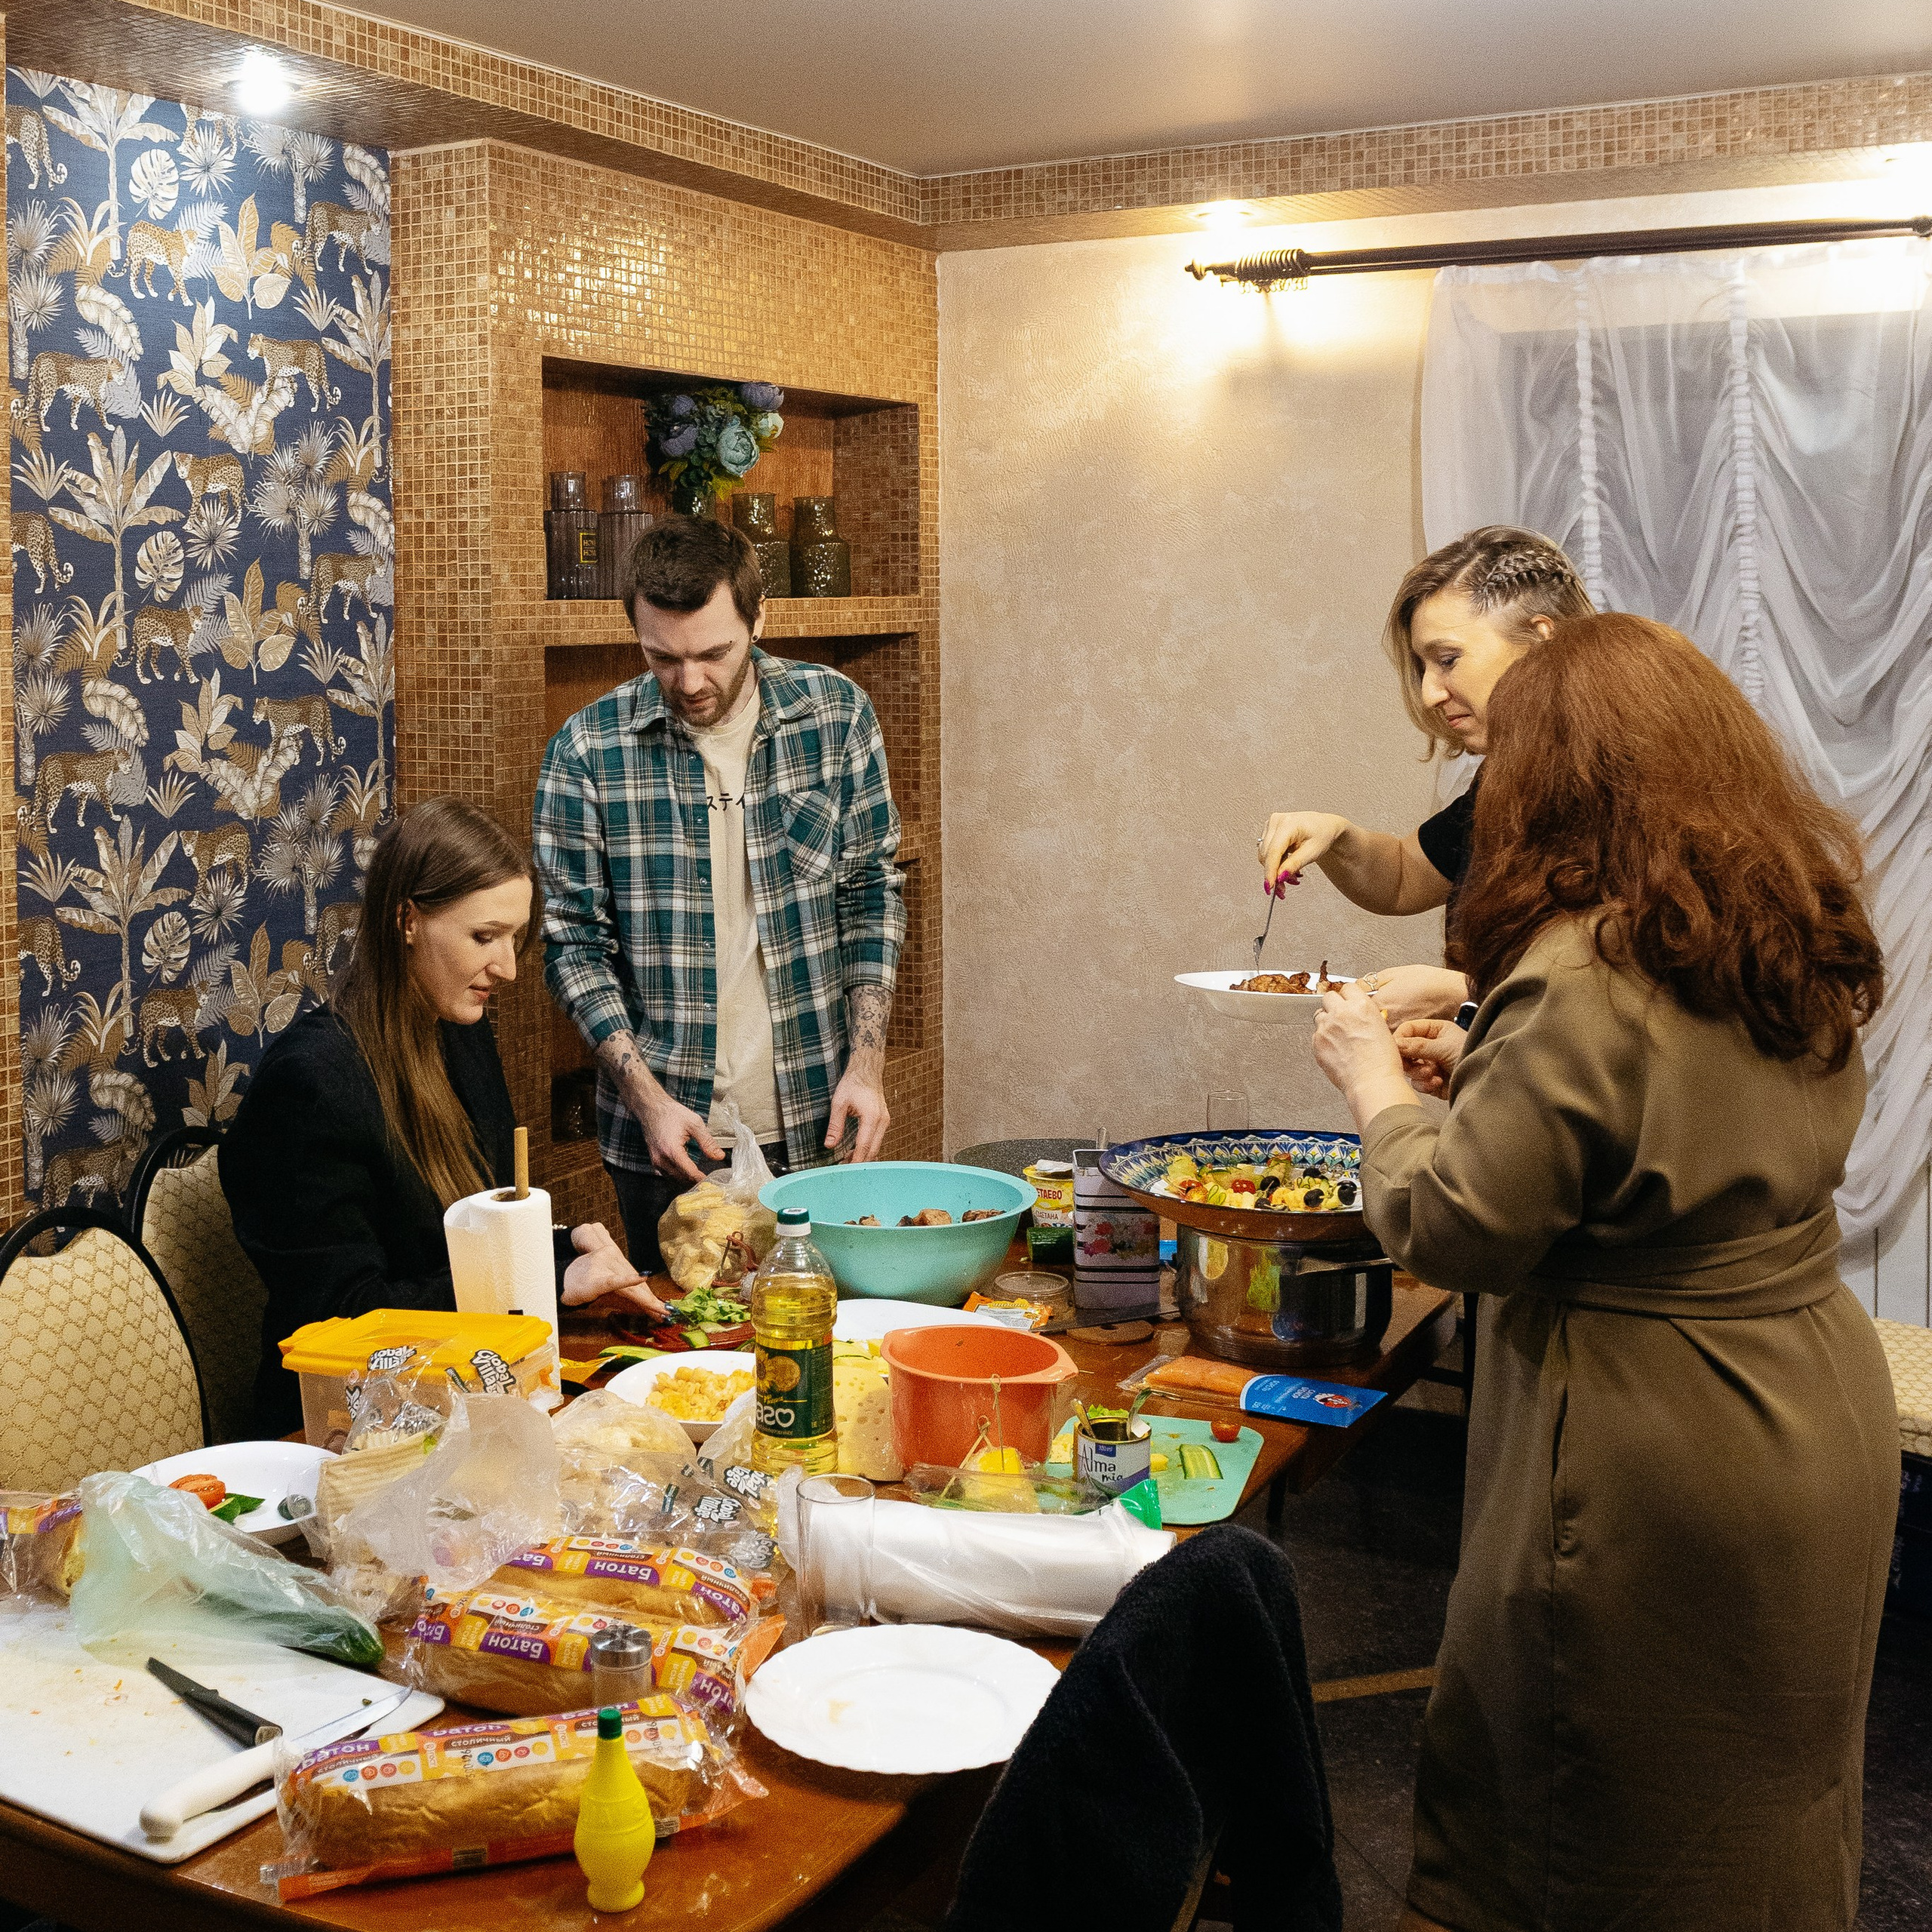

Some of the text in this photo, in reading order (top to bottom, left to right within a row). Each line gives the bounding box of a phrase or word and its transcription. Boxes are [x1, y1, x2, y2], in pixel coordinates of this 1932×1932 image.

[1078, 1444, 1116, 1472] Alma
[1102, 1473, 1123, 1482] mia
[594, 1561, 652, 1580] Батон
[488, 1635, 543, 1659] Батон
[581, 1715, 640, 1727] стоый
[451, 1736, 511, 1748] столичный
